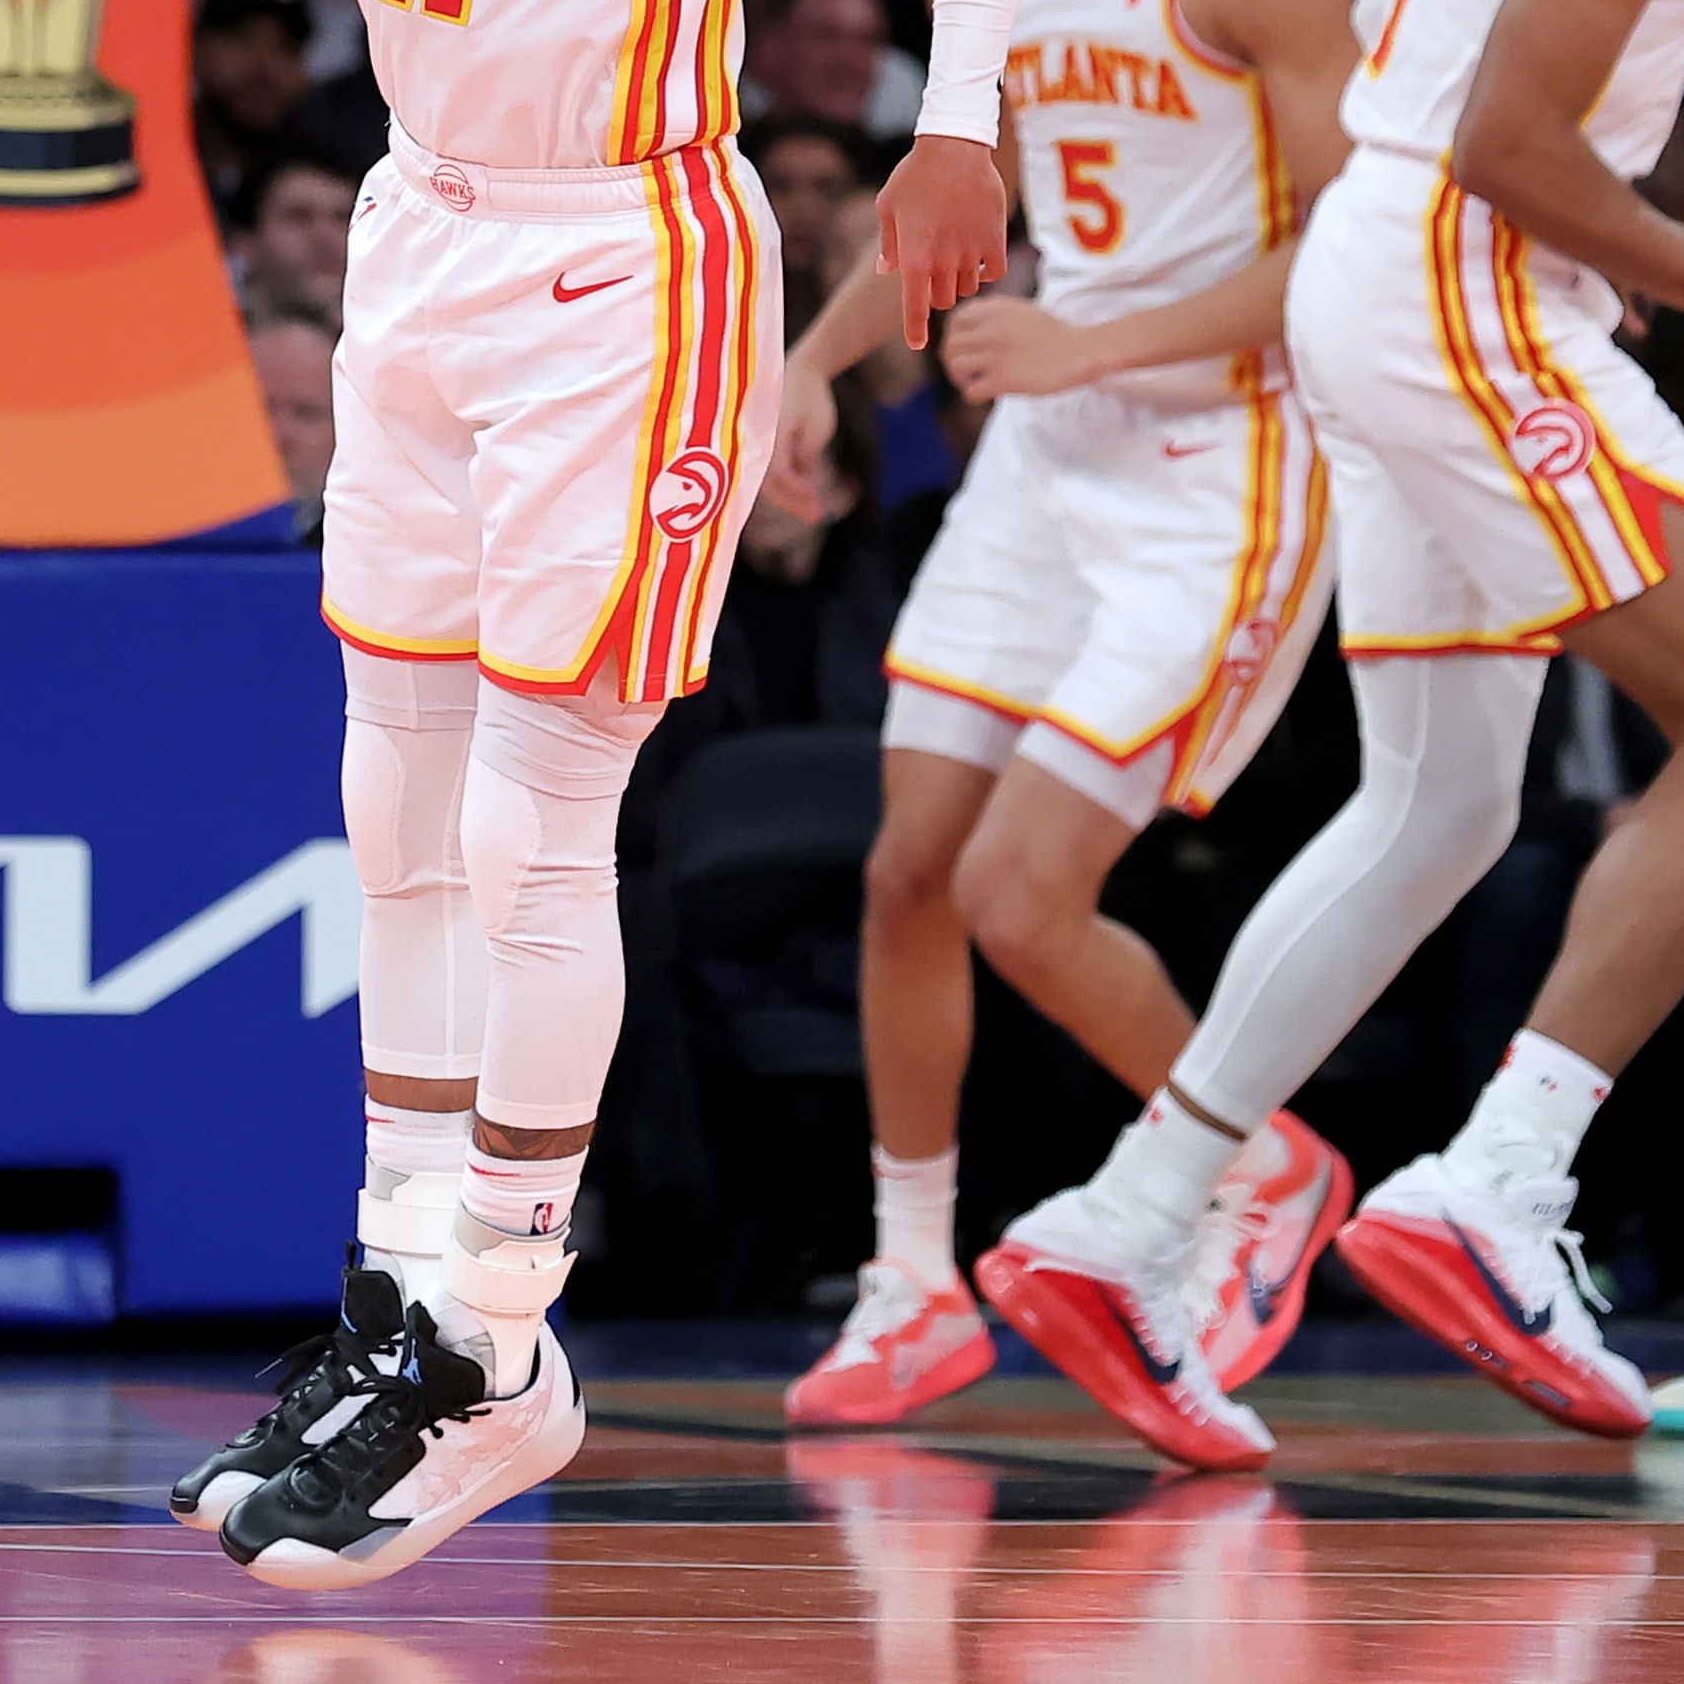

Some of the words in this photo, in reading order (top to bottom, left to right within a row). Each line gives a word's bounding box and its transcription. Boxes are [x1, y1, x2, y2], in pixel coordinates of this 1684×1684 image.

[1006, 43, 1201, 123] TLANTA
[429, 176, 476, 201] HAWKS
[1054, 138, 1124, 256] 5
